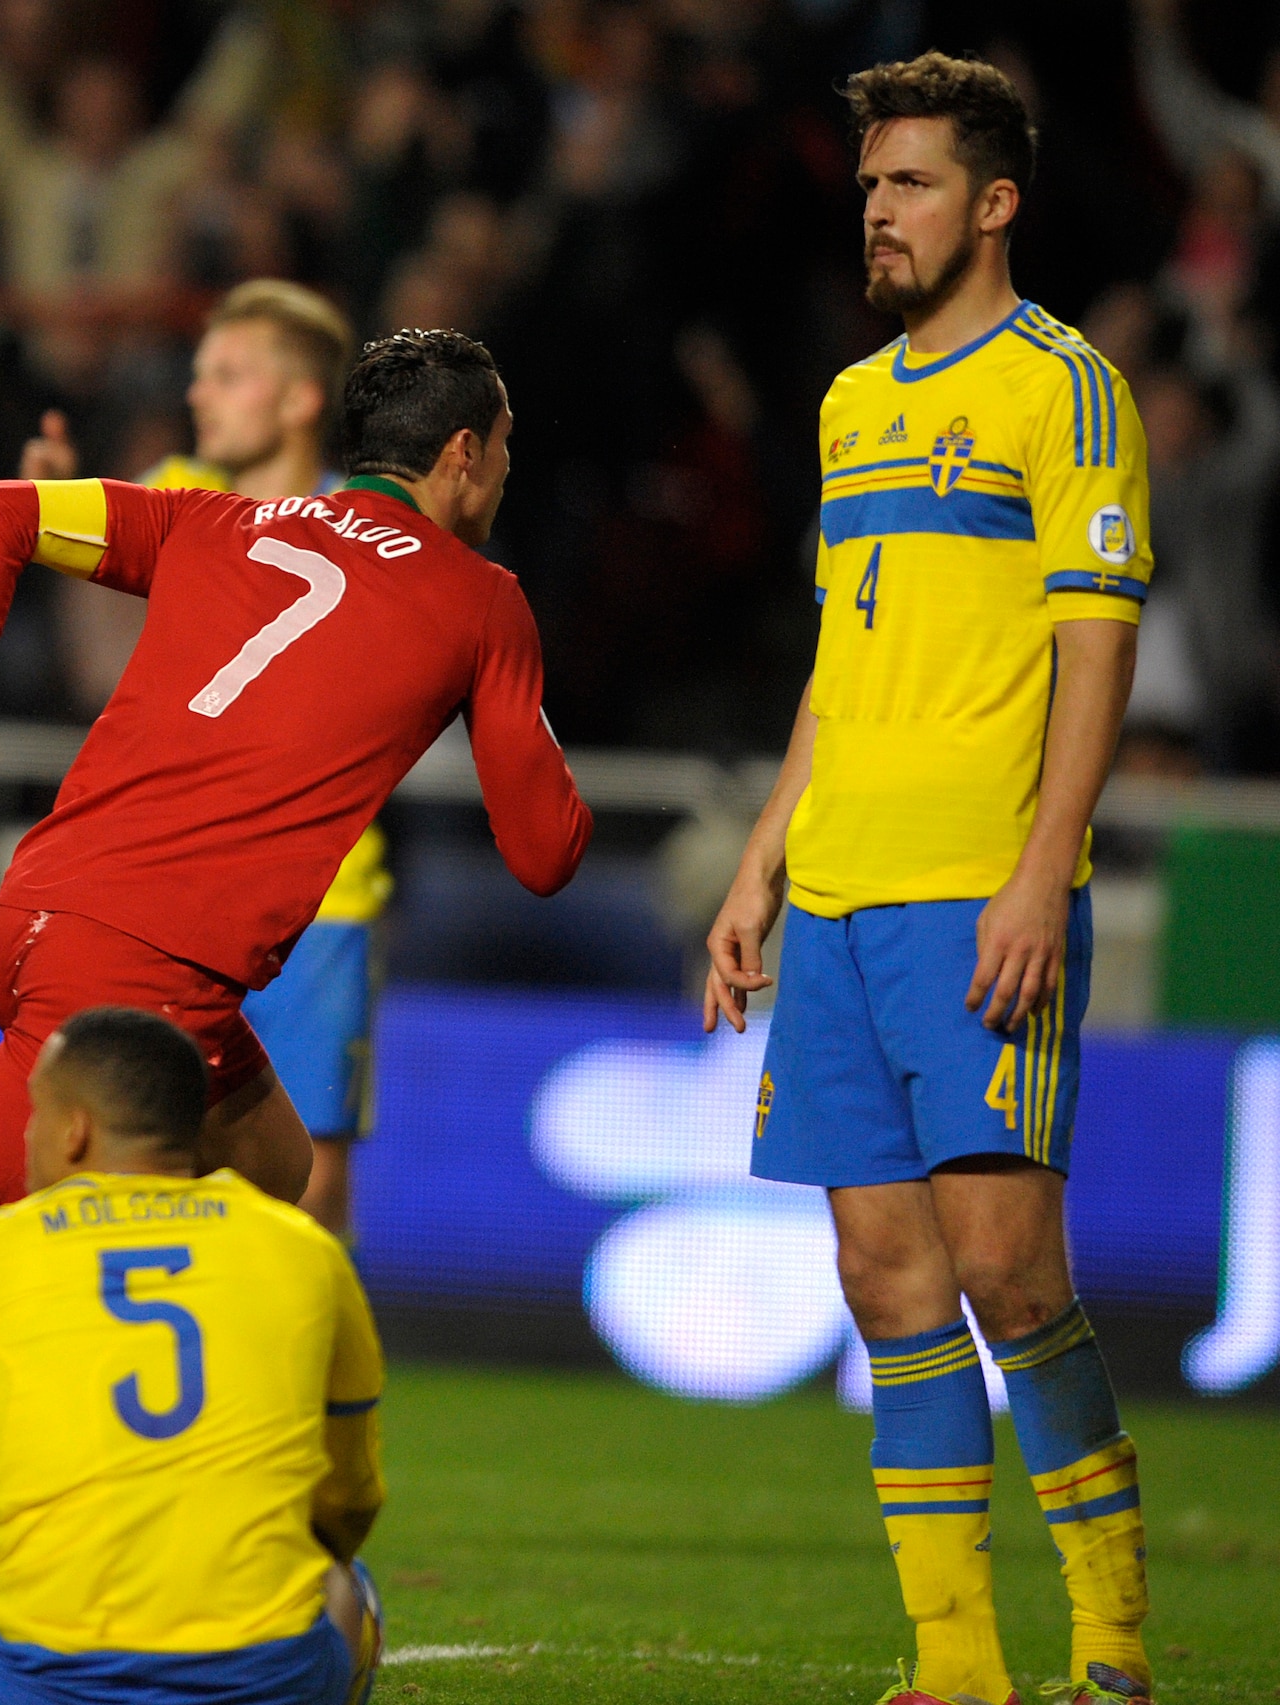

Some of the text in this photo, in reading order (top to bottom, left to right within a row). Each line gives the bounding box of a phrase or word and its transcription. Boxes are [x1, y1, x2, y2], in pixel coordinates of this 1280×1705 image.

[878, 431, 908, 446] adidas
[253, 496, 422, 560] RONALDO
[187, 536, 347, 718] 7
[855, 541, 882, 630] 4
[984, 1042, 1018, 1130] 4
[98, 1245, 206, 1441] 5
